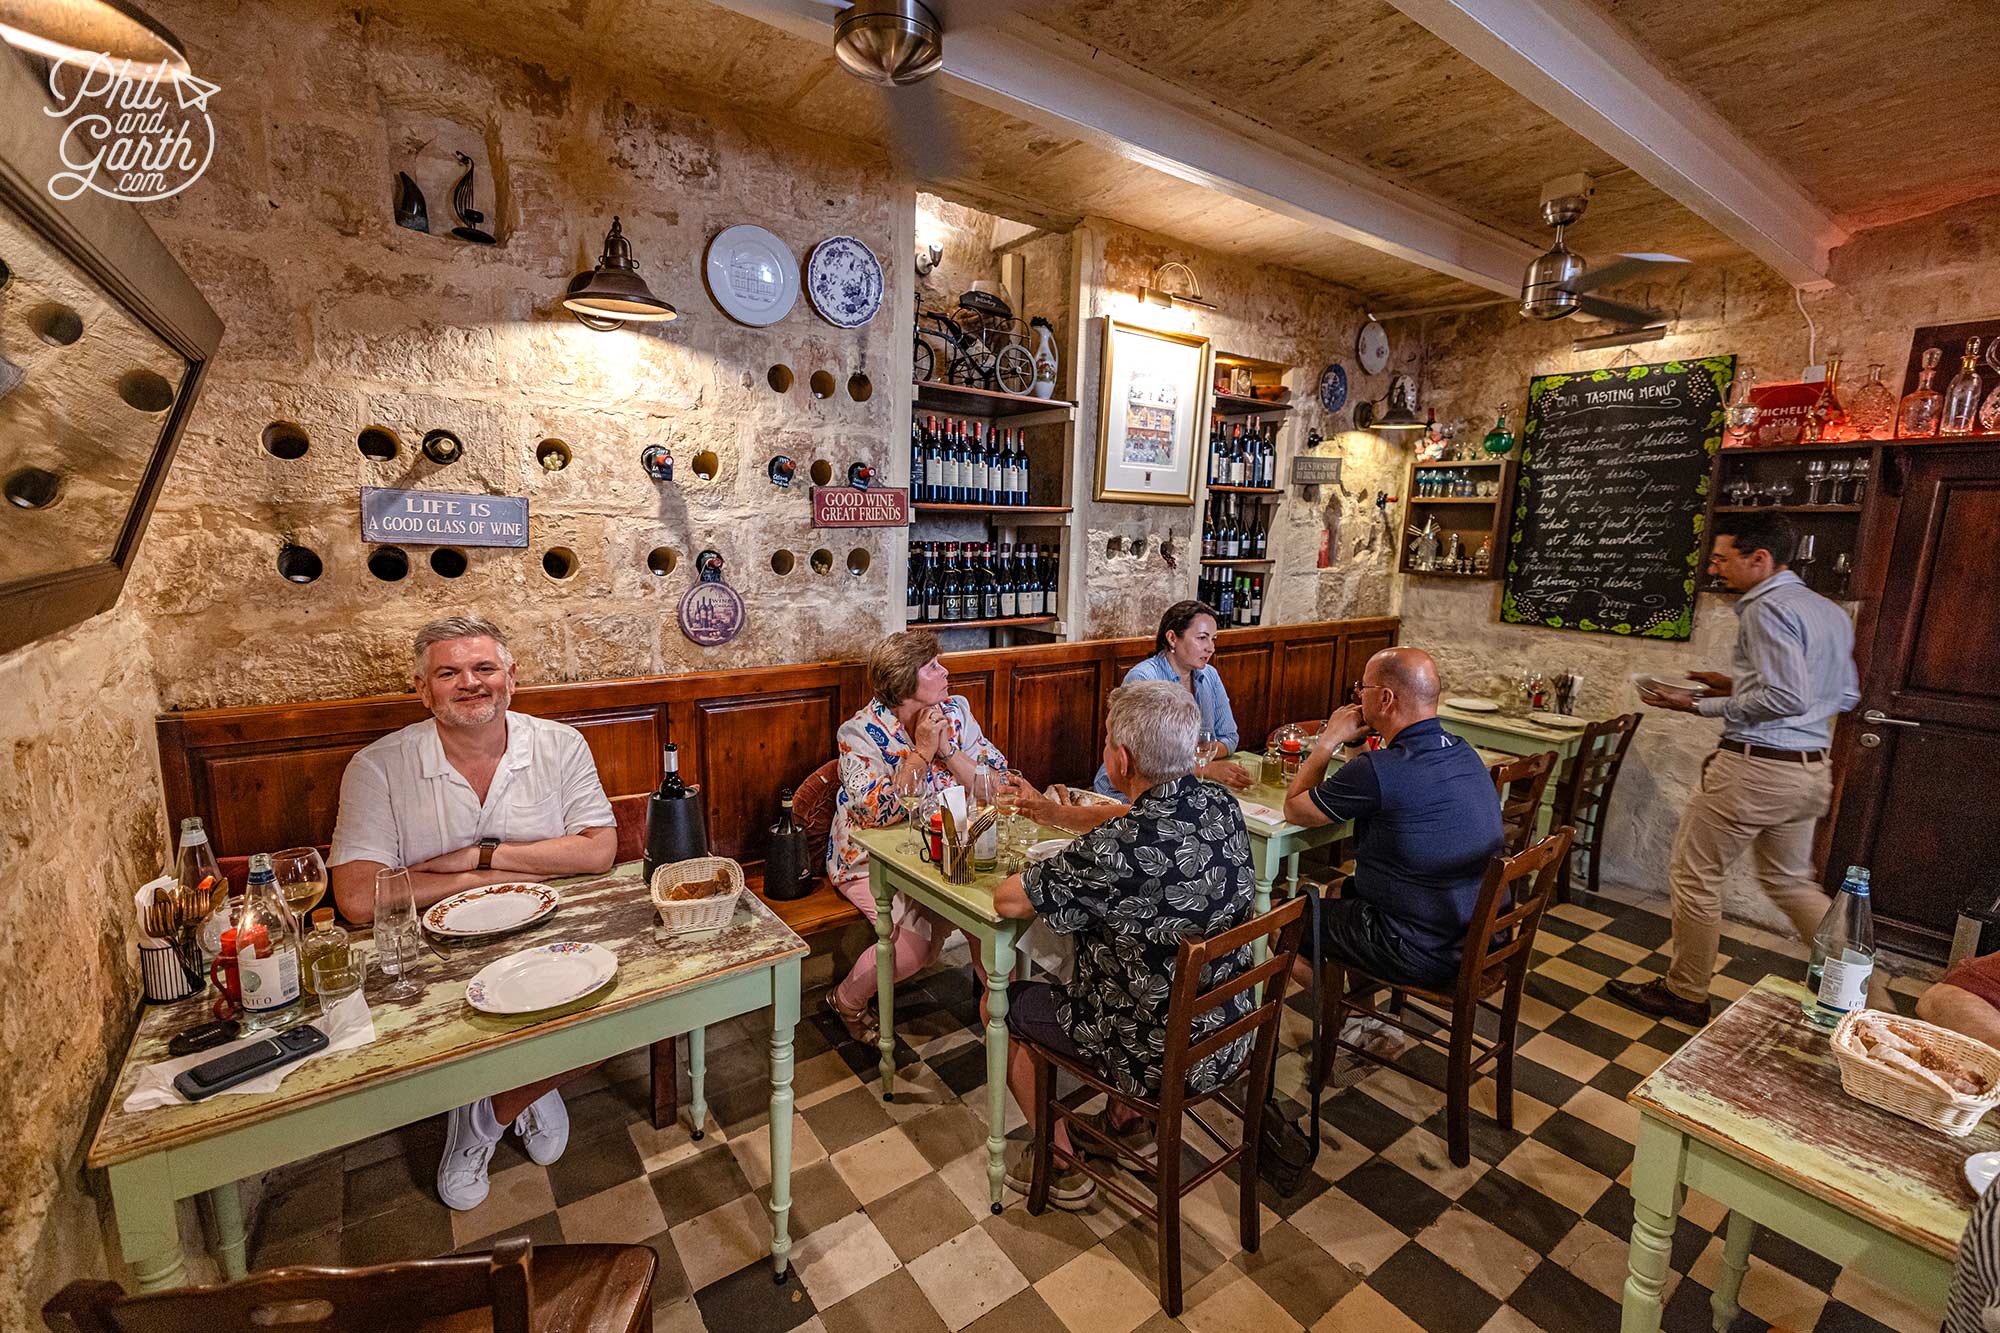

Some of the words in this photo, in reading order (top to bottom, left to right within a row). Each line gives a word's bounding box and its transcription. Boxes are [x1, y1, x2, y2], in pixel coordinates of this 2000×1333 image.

[1555, 394, 1579, 407] OUR
[1585, 388, 1634, 404] TASTING
[1639, 380, 1677, 399] MENU
[1771, 417, 1797, 426] 2024
[1535, 443, 1549, 462] of
[1634, 431, 1690, 449] Maltese
[1537, 484, 1558, 499] The
[825, 492, 864, 507] GOOD
[866, 493, 895, 507] WINE
[406, 498, 461, 516] LIFE
[470, 502, 491, 518] IS
[821, 507, 857, 521] GREAT
[859, 507, 901, 520] FRIENDS
[1566, 503, 1584, 513] to
[368, 516, 379, 531] A
[382, 516, 423, 532] GOOD
[427, 519, 466, 534] GLASS
[469, 521, 485, 535] OF
[490, 522, 523, 536] WINE
[1539, 517, 1570, 530] what
[1546, 533, 1567, 546] at
[1570, 531, 1595, 546] the
[1532, 574, 1580, 588] between
